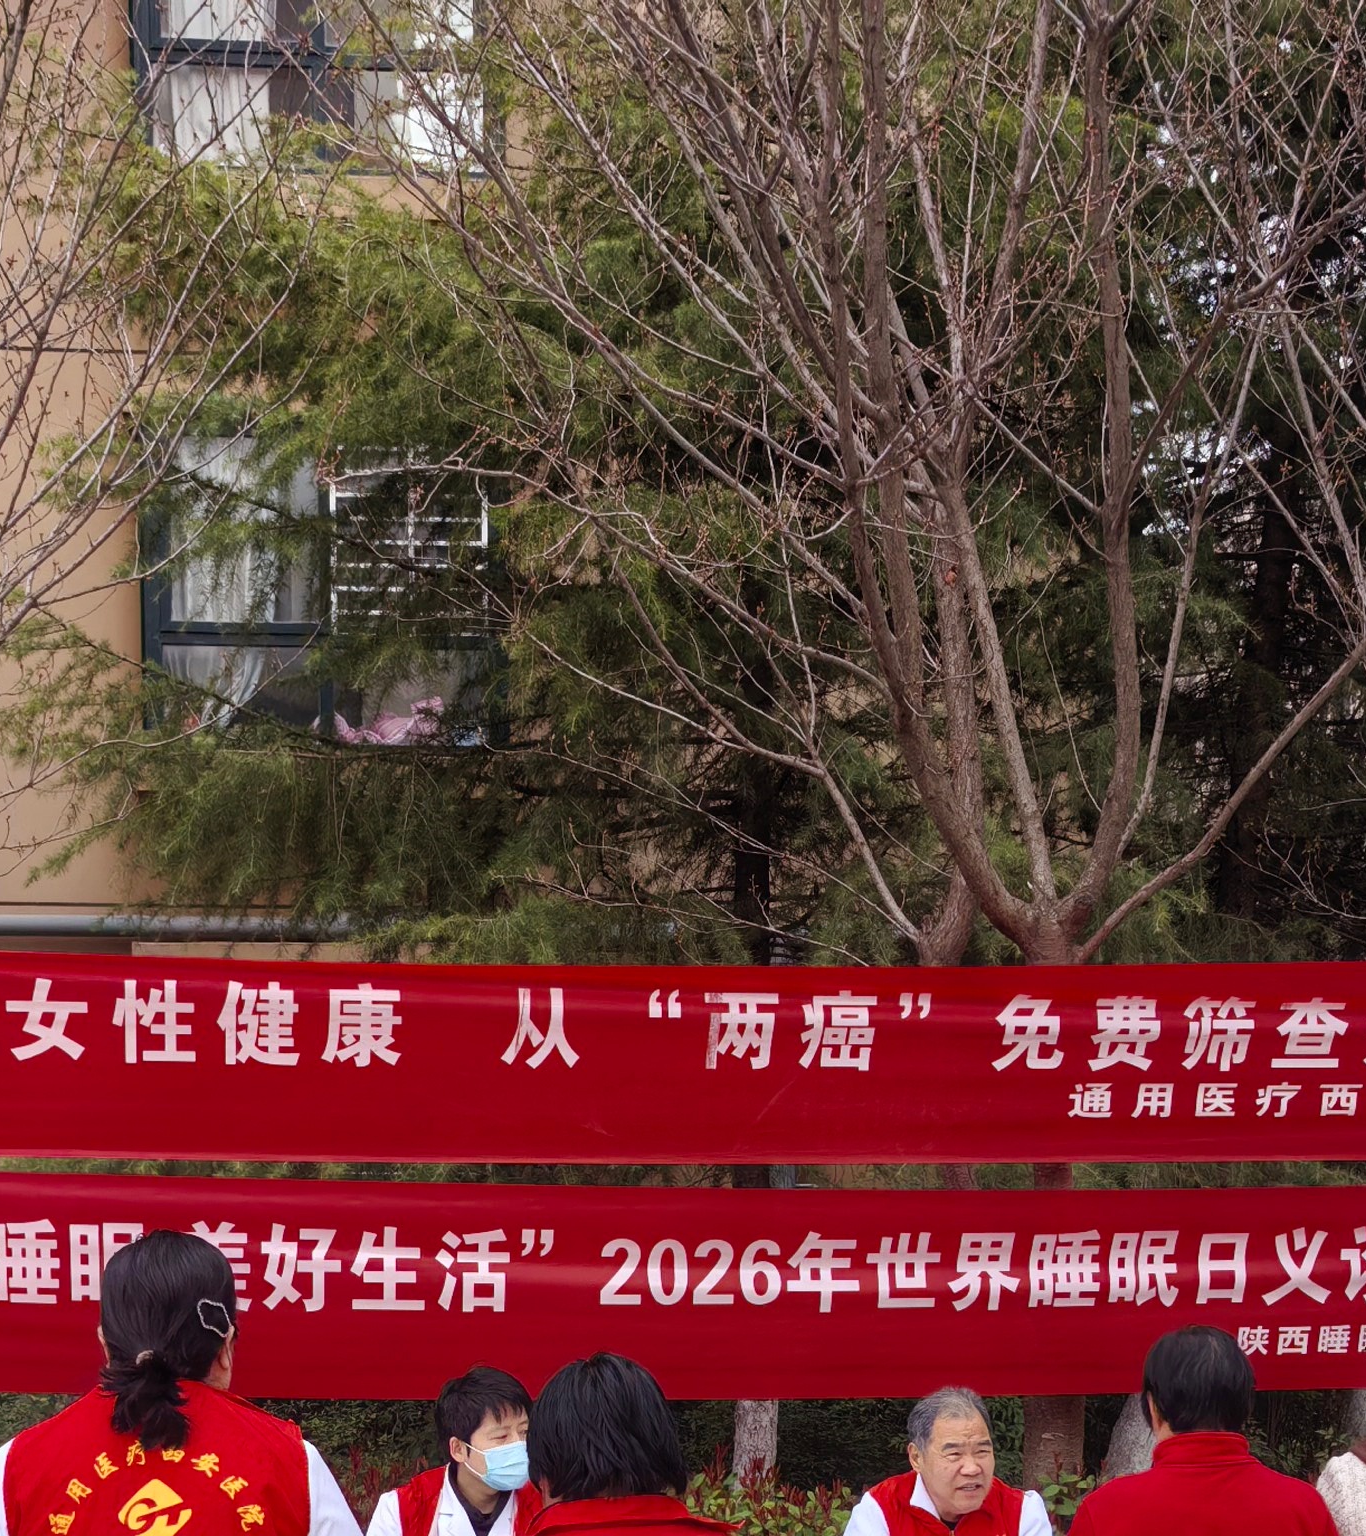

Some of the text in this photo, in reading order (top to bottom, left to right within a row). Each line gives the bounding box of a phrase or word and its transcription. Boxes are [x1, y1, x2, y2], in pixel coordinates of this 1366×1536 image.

[501, 987, 580, 1069] 从
[649, 989, 931, 1071] “两癌”
[49, 1440, 266, 1536] 通用医疗西安医院
